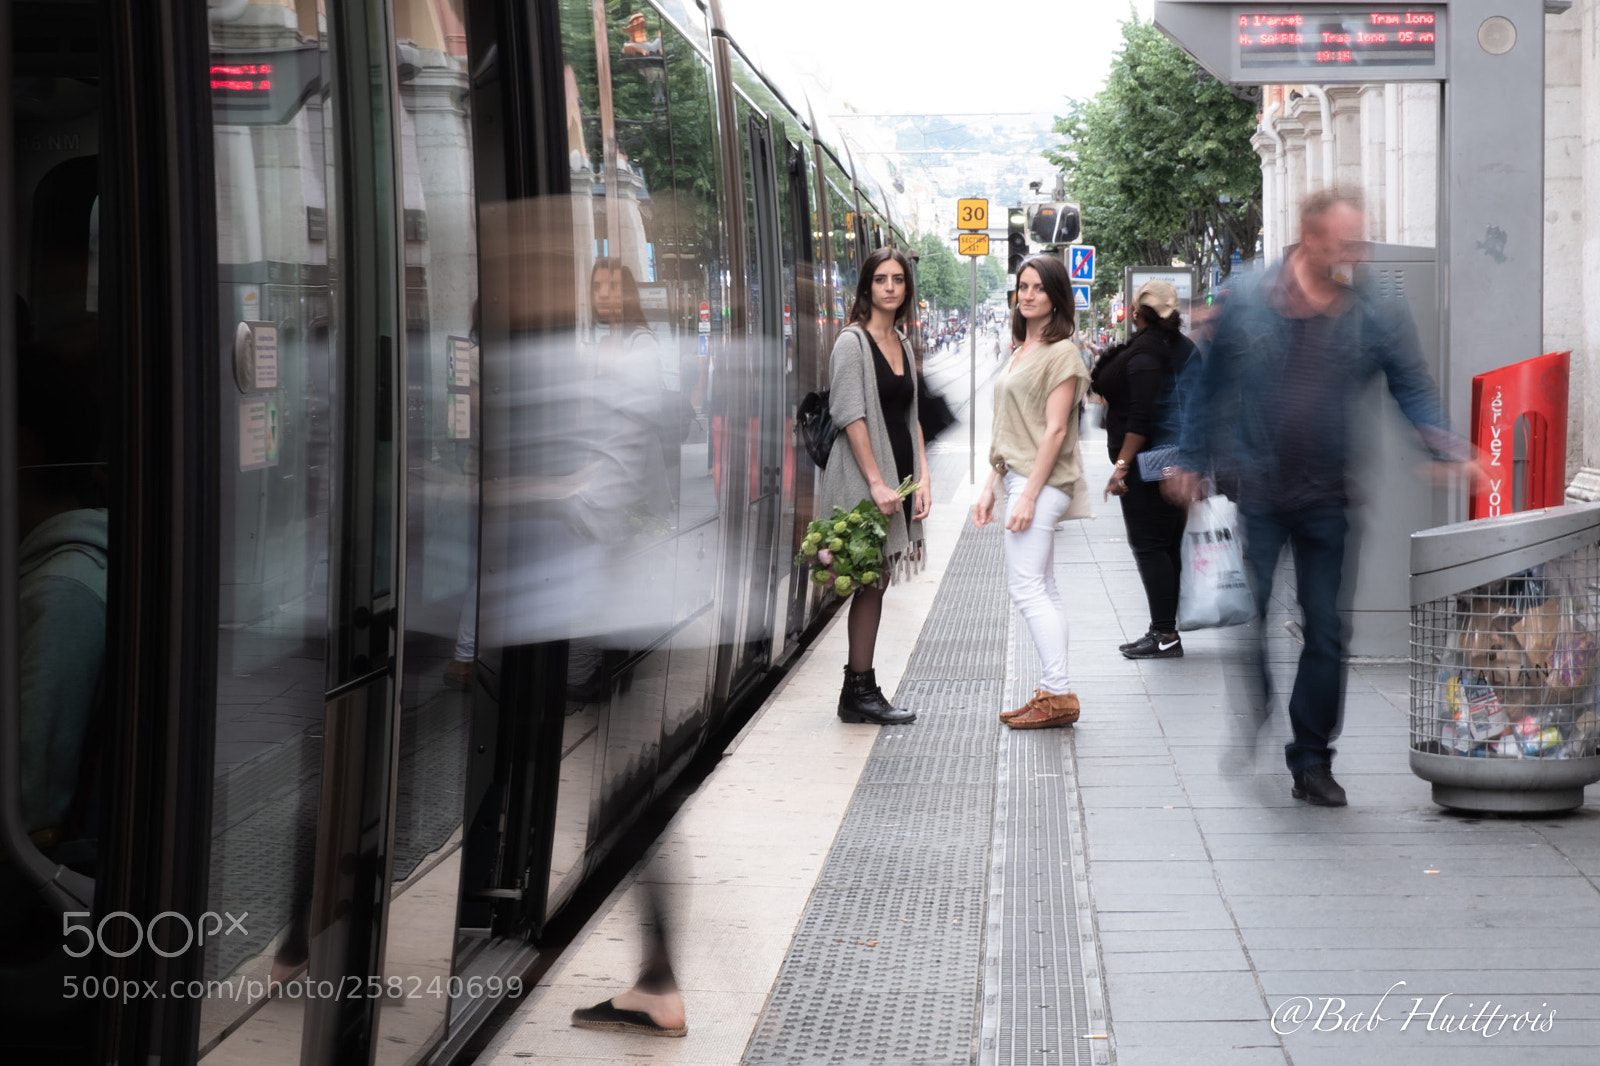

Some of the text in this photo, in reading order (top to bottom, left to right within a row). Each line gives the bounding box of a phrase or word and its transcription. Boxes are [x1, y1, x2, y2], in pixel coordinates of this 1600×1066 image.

[1239, 15, 1248, 27] A
[1370, 13, 1400, 25] Tram
[1239, 33, 1253, 45] H.
[962, 206, 985, 222] 30
